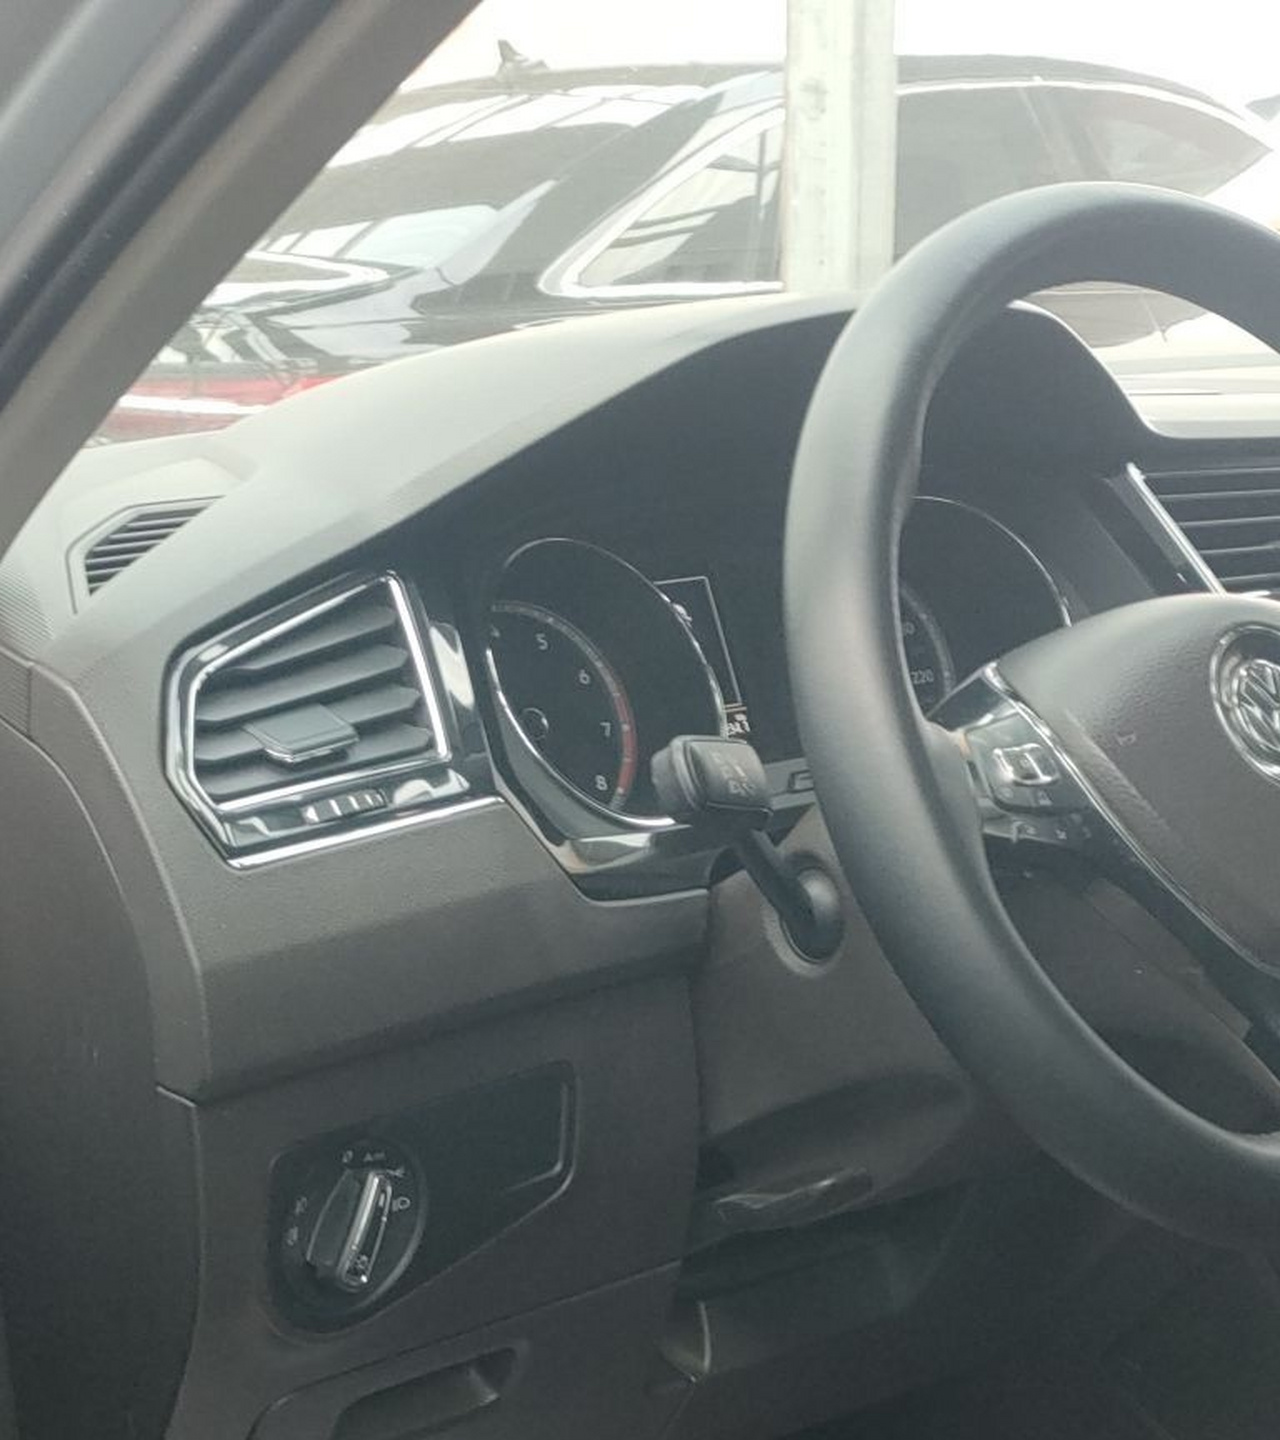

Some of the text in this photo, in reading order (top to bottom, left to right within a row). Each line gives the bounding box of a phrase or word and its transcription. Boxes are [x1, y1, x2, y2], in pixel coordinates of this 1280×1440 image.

[535, 633, 548, 650] 5
[578, 670, 590, 684] 6
[600, 722, 611, 737] 7
[595, 775, 608, 791] 8
